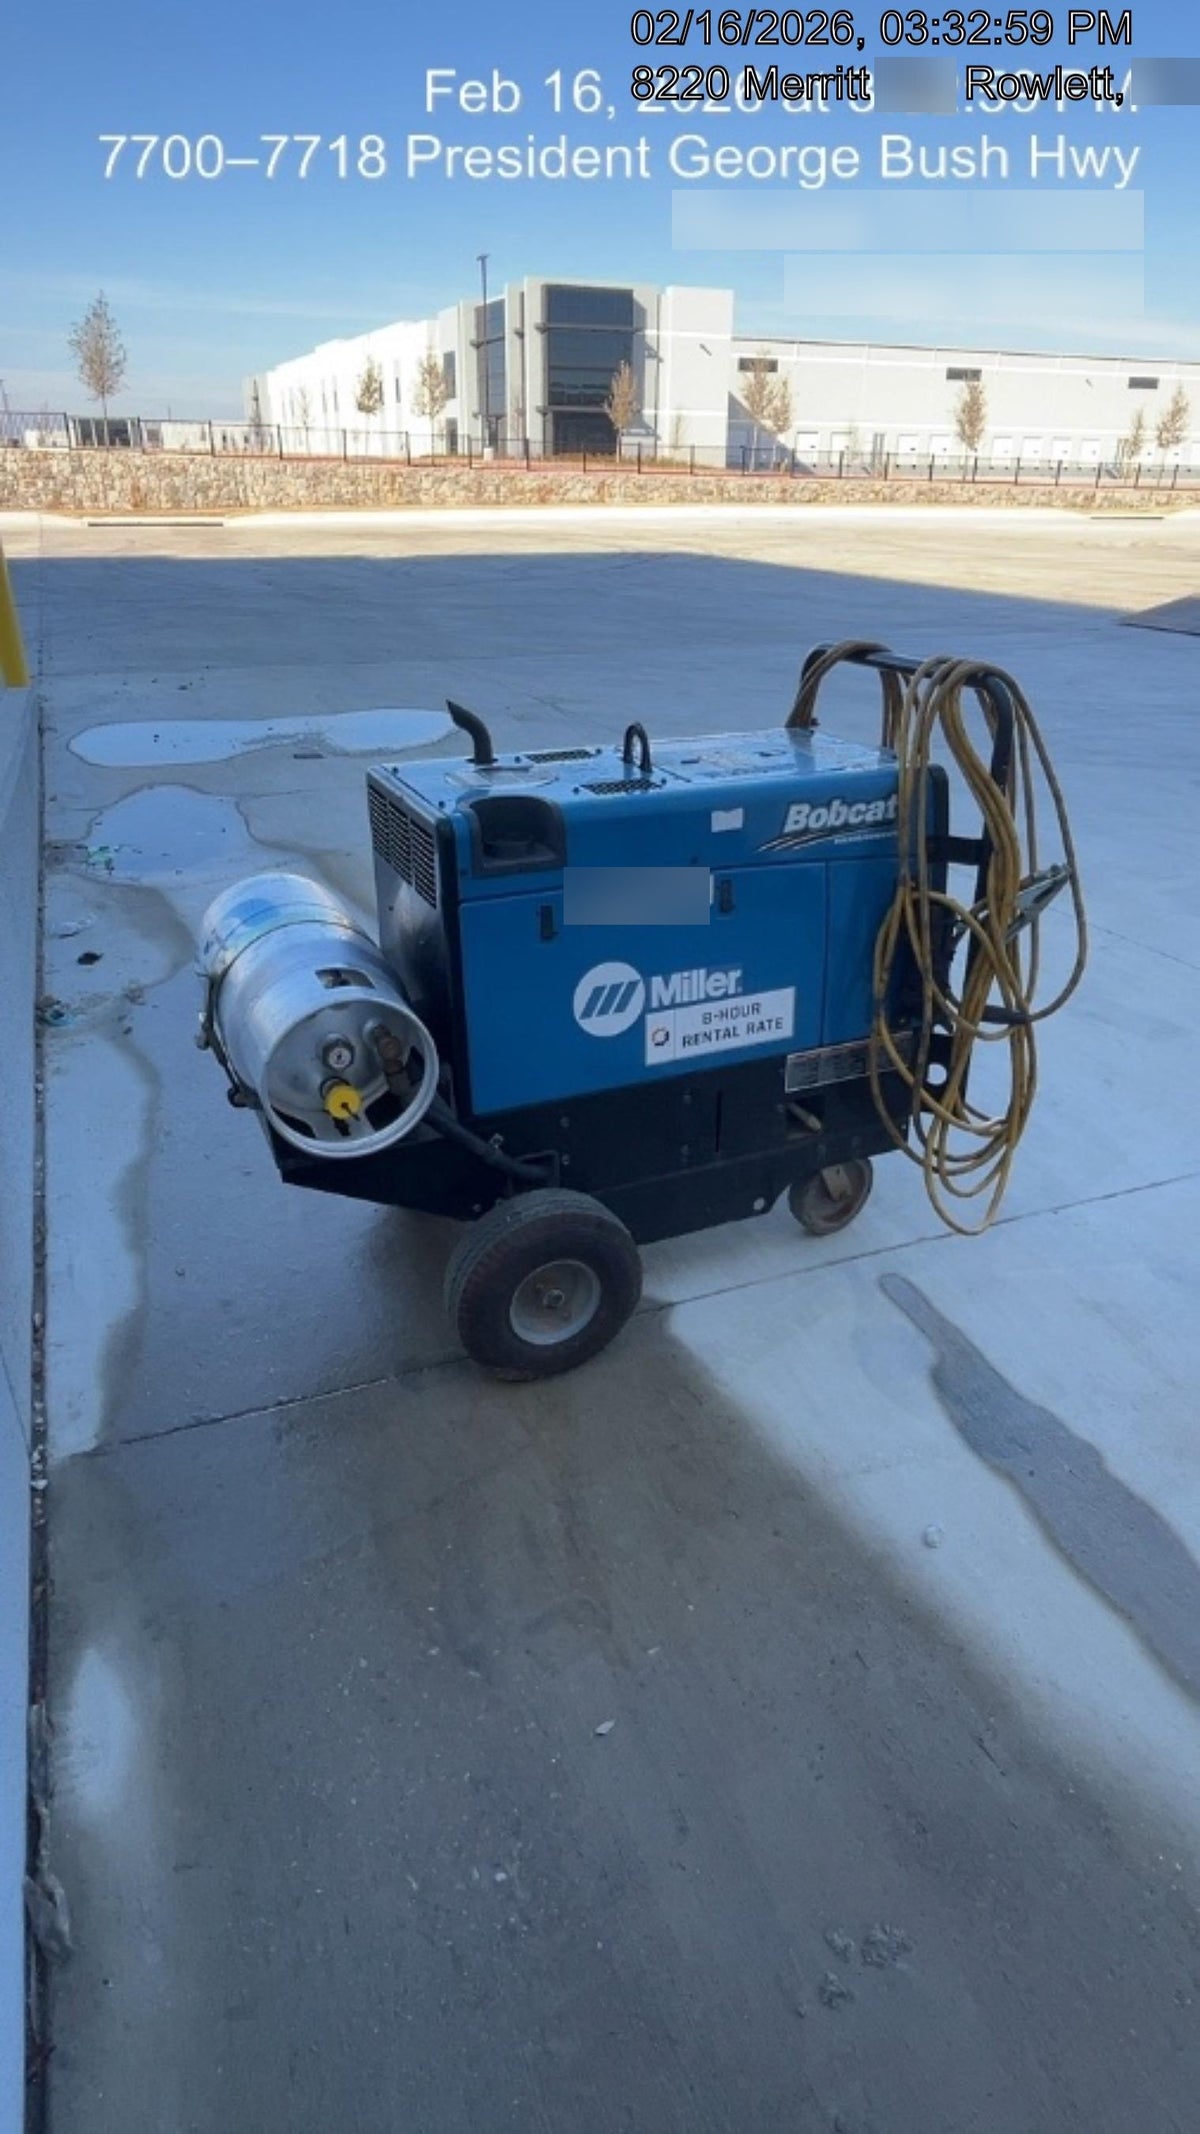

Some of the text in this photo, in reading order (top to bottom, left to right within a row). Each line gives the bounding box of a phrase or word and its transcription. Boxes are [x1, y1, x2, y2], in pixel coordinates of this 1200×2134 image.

[783, 794, 898, 833] Bobcat
[651, 967, 742, 1009] Miller
[702, 1002, 761, 1026] 8-HOUR
[682, 1017, 784, 1048] RENTAL RATE
